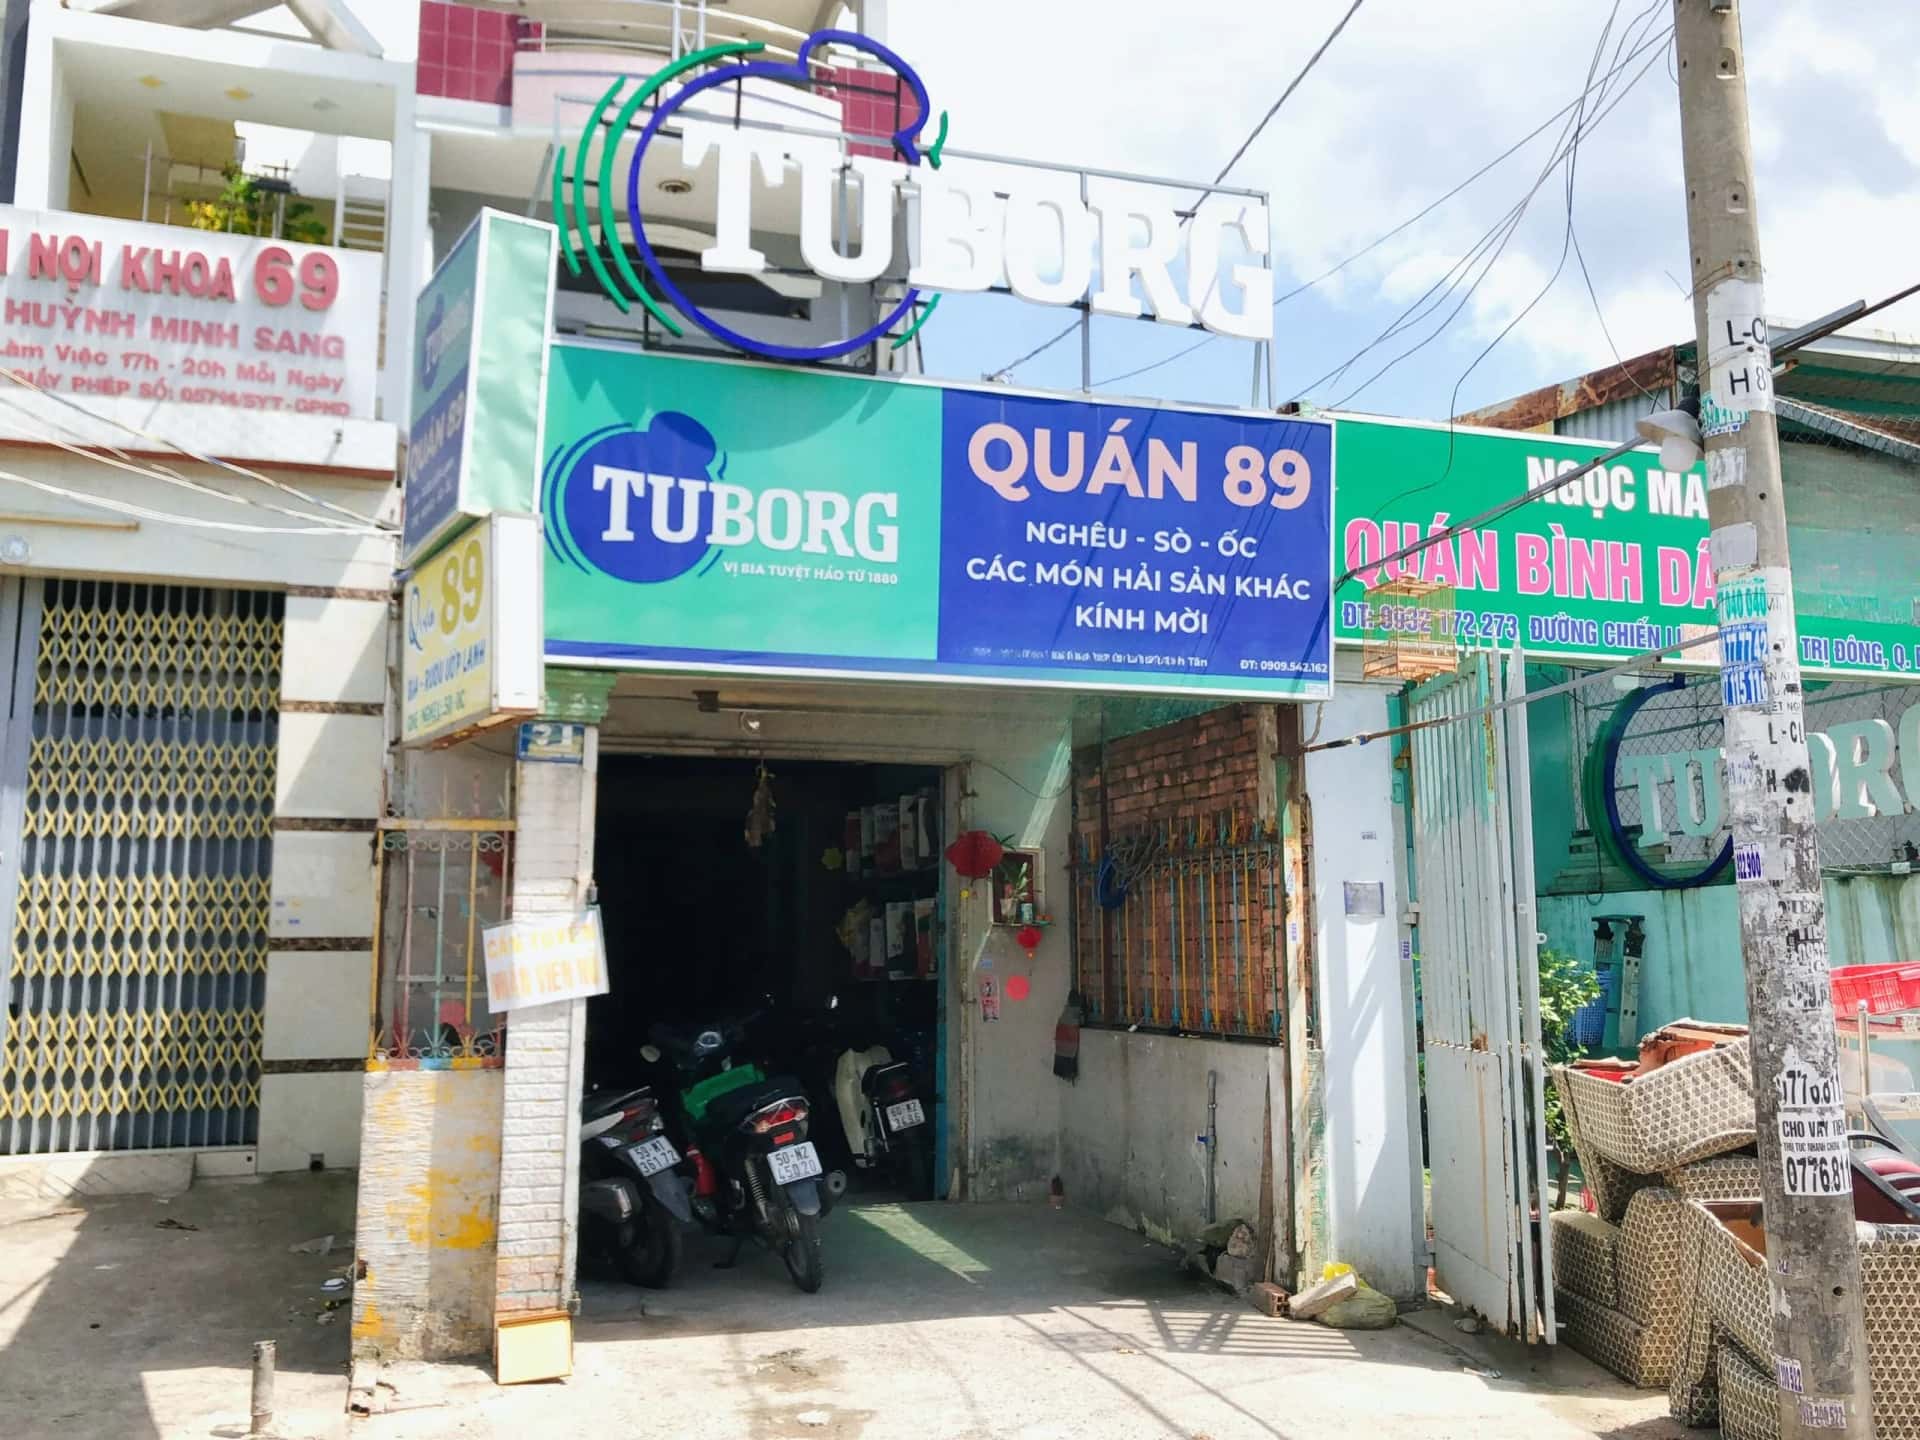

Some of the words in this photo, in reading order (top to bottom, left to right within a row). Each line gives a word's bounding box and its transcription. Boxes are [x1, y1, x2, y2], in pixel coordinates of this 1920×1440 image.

[682, 118, 1272, 341] TUBORG
[122, 245, 236, 303] KHOA
[255, 246, 339, 312] 69
[151, 316, 238, 349] MINH
[255, 327, 344, 359] SANG
[968, 419, 1198, 502] QUÁN
[1223, 445, 1312, 510] 89
[1525, 456, 1635, 518] NGỌC
[593, 465, 899, 563] TUBORG
[1026, 521, 1127, 549] NGHÊU
[1154, 527, 1191, 553] SÒ
[1218, 529, 1257, 558] ỐC
[1345, 511, 1500, 594] QUÁN
[1515, 522, 1643, 604] BÌNH
[440, 539, 484, 636] 89
[741, 563, 765, 575] BIA
[966, 554, 1026, 582] CÁC
[1036, 559, 1103, 588] MÓN
[1113, 562, 1160, 591] HẢI
[1170, 566, 1225, 595] SẢN
[1236, 575, 1311, 600] KHÁC
[1075, 602, 1144, 631] KÍNH
[1155, 606, 1209, 633] MỜI
[1530, 612, 1599, 645] ĐƯỜNG
[1604, 616, 1661, 649] CHIẾN
[1801, 636, 1830, 667] TRỊ
[1783, 1120, 1805, 1138] CHO
